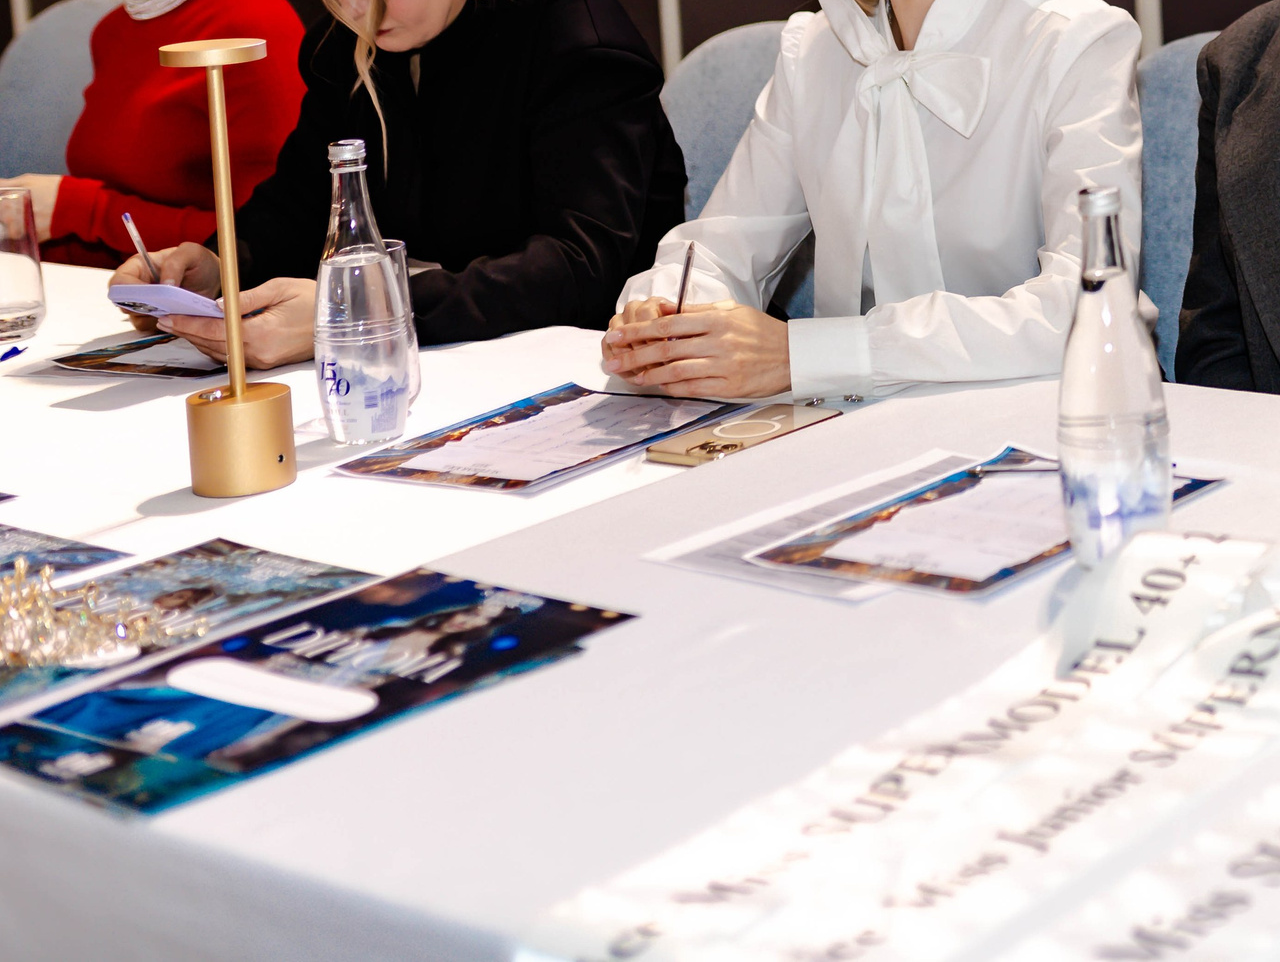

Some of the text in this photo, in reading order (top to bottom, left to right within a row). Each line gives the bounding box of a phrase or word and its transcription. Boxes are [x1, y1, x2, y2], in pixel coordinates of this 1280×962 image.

[1128, 551, 1201, 616] 40+
[996, 766, 1145, 854] Junior
[1093, 889, 1253, 962] Miss
